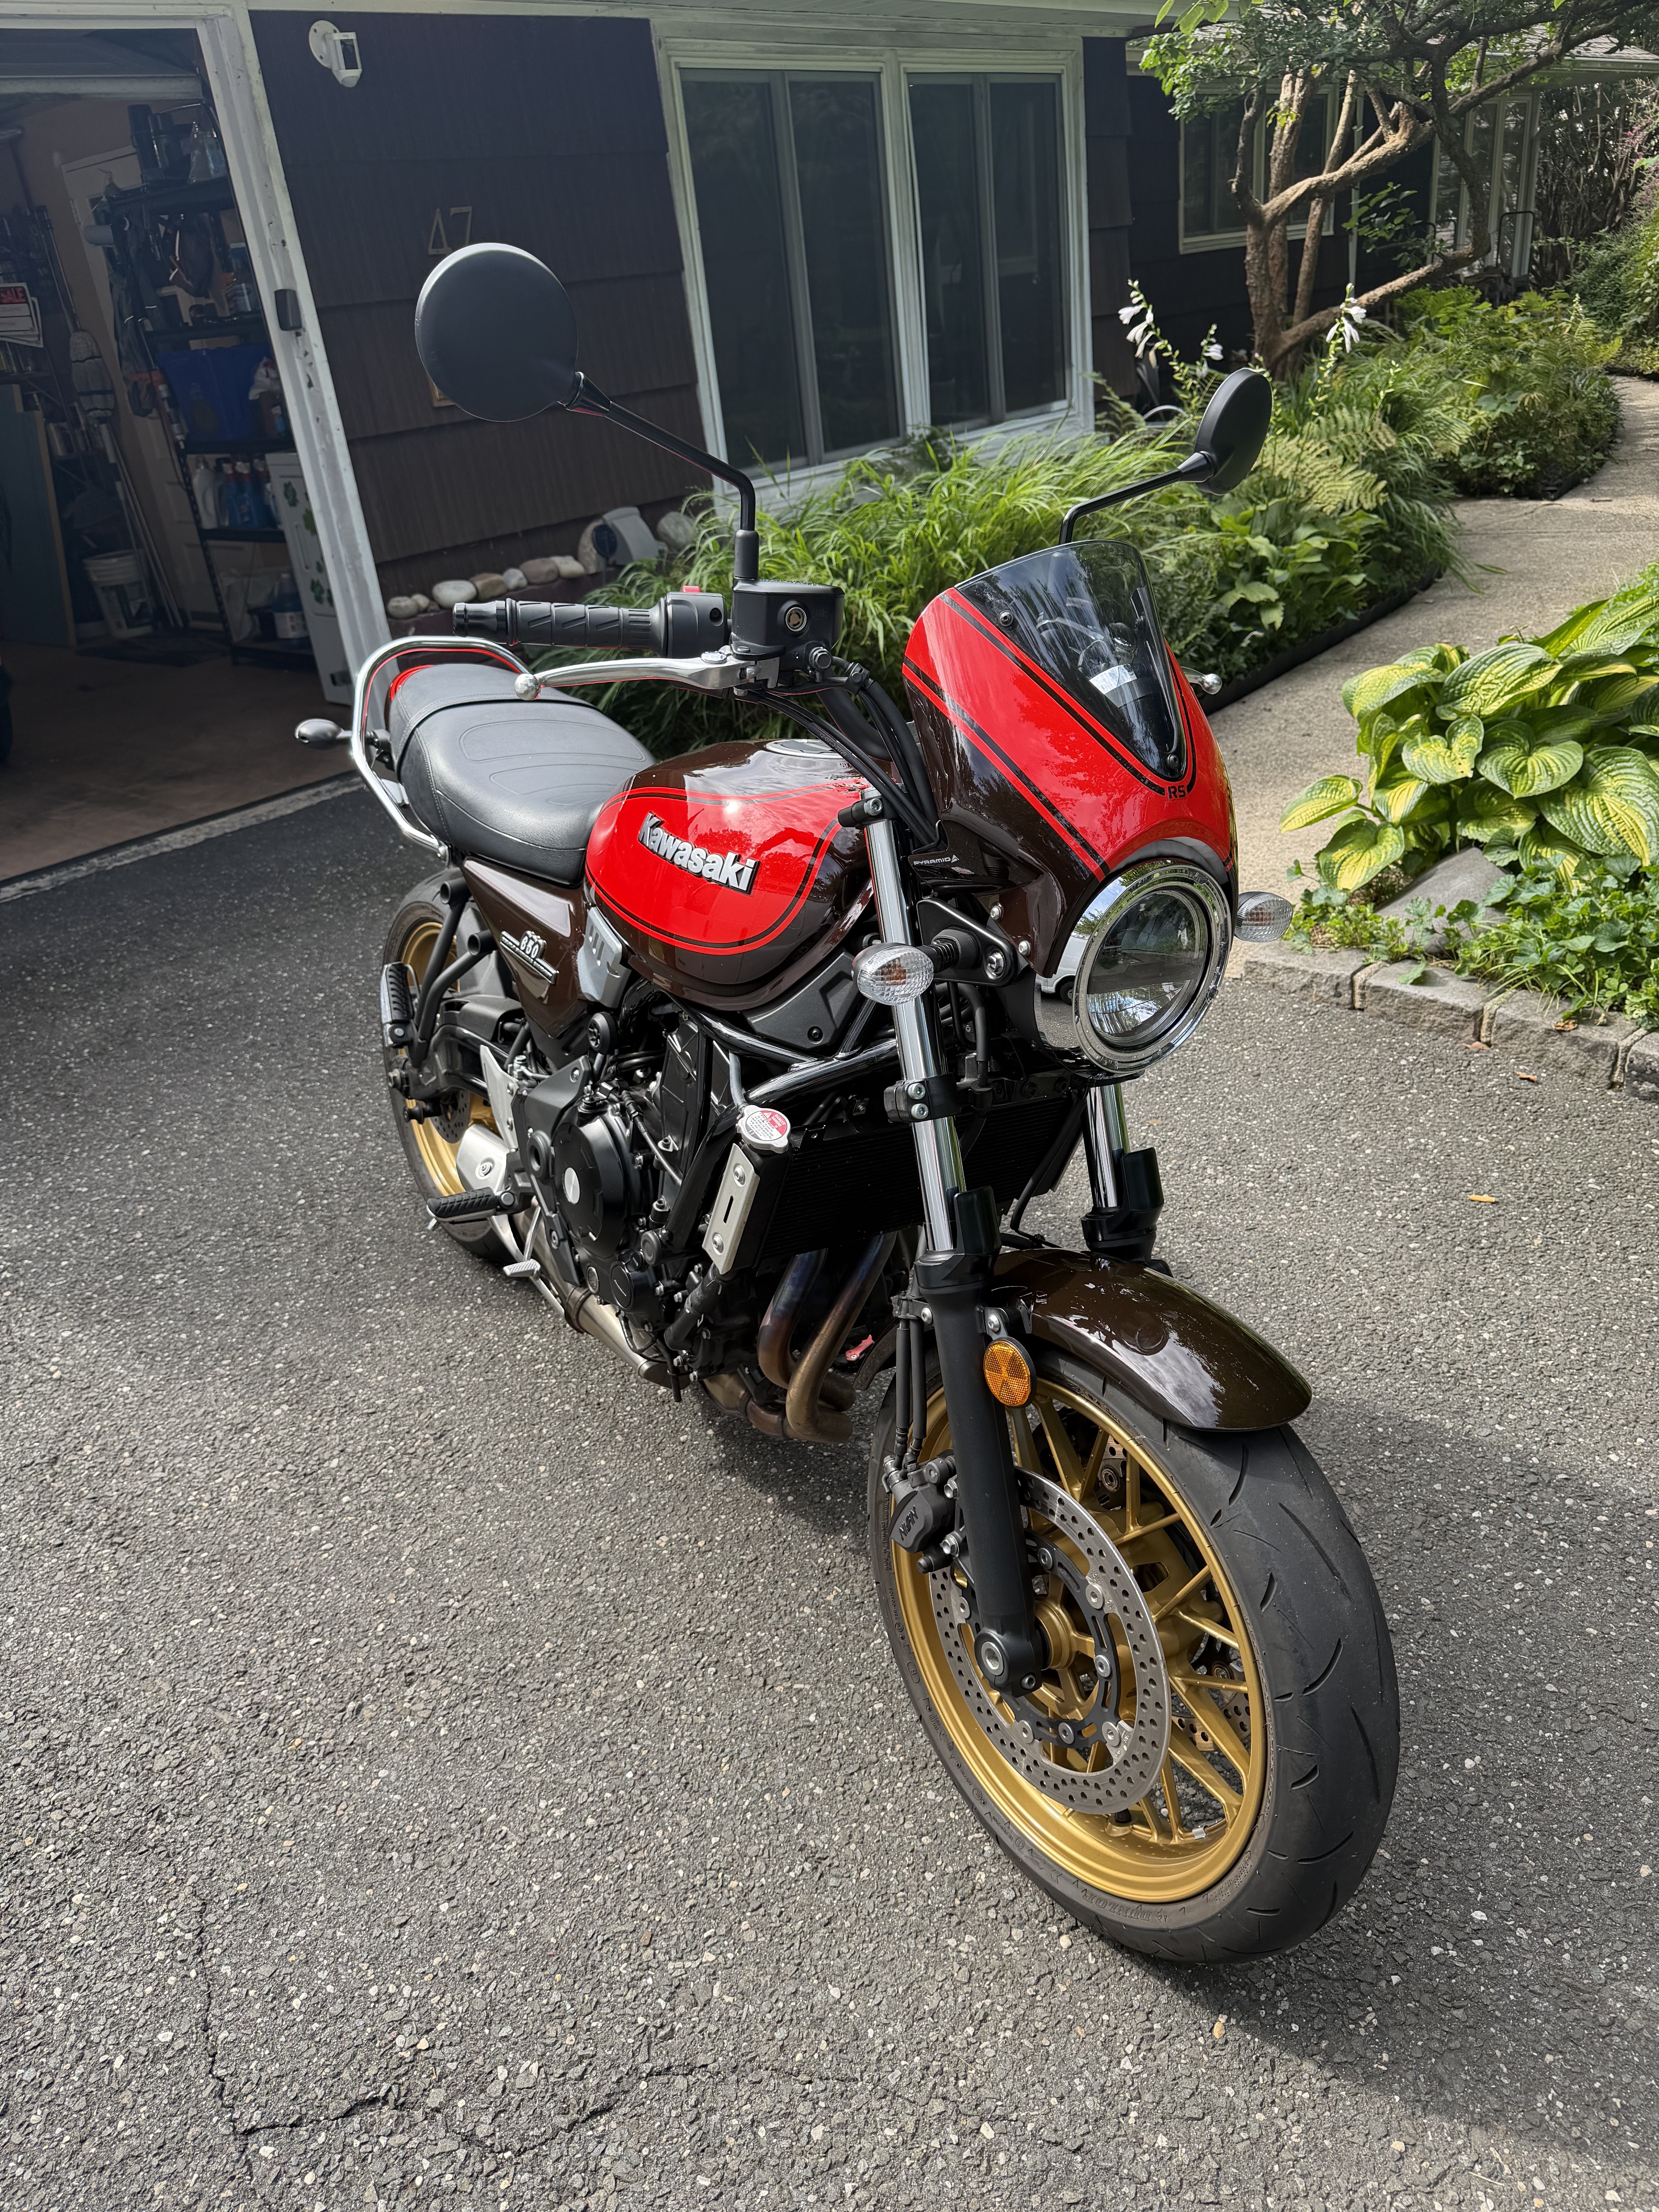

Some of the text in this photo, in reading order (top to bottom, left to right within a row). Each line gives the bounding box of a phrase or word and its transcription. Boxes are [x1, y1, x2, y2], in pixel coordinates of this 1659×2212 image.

[428, 206, 472, 256] 47
[0, 287, 26, 303] SALE
[1168, 785, 1186, 799] RS
[638, 812, 757, 892] Kawasaki
[913, 857, 951, 866] PYRAMID
[520, 935, 539, 958] 650
[1082, 1891, 1153, 1922] DUNLOP
